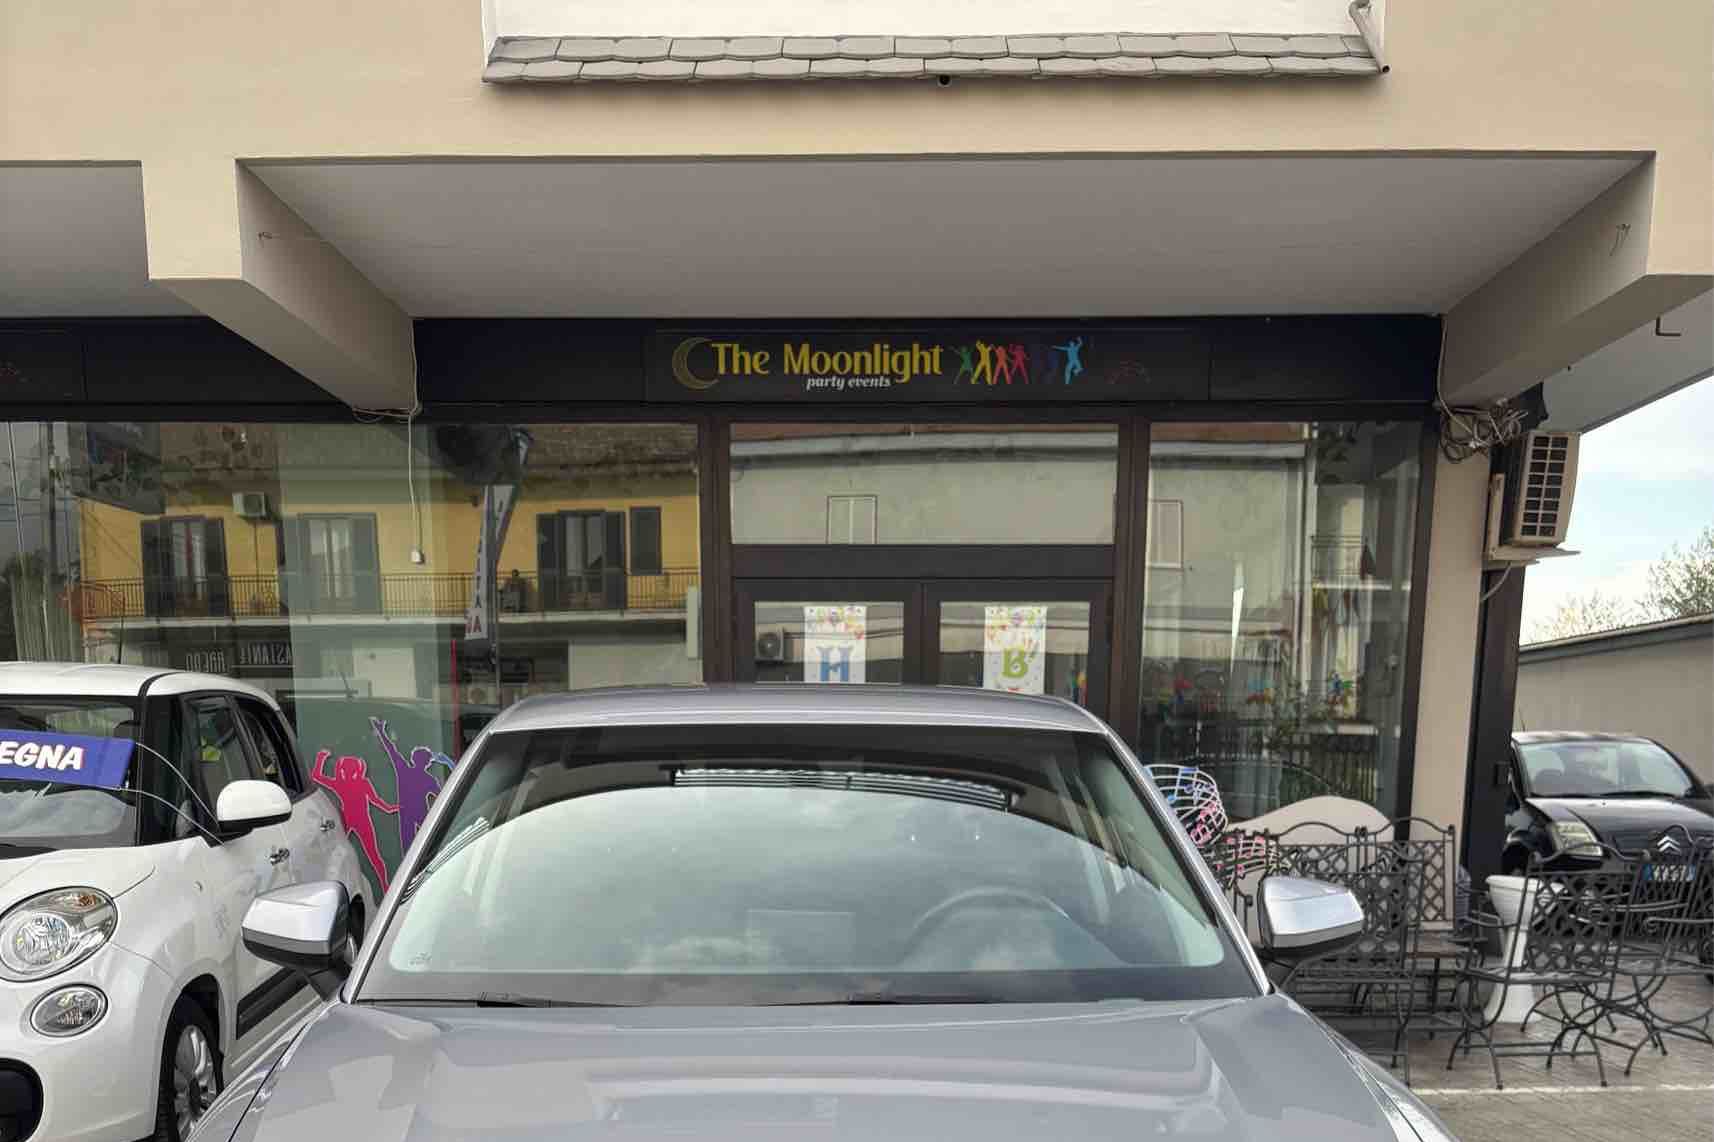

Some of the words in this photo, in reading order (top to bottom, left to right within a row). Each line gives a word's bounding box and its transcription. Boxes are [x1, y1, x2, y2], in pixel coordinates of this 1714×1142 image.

[711, 342, 770, 375] The
[783, 342, 944, 383] Moonlight
[806, 375, 845, 391] party
[847, 376, 892, 388] events
[0, 741, 84, 771] EGNA
